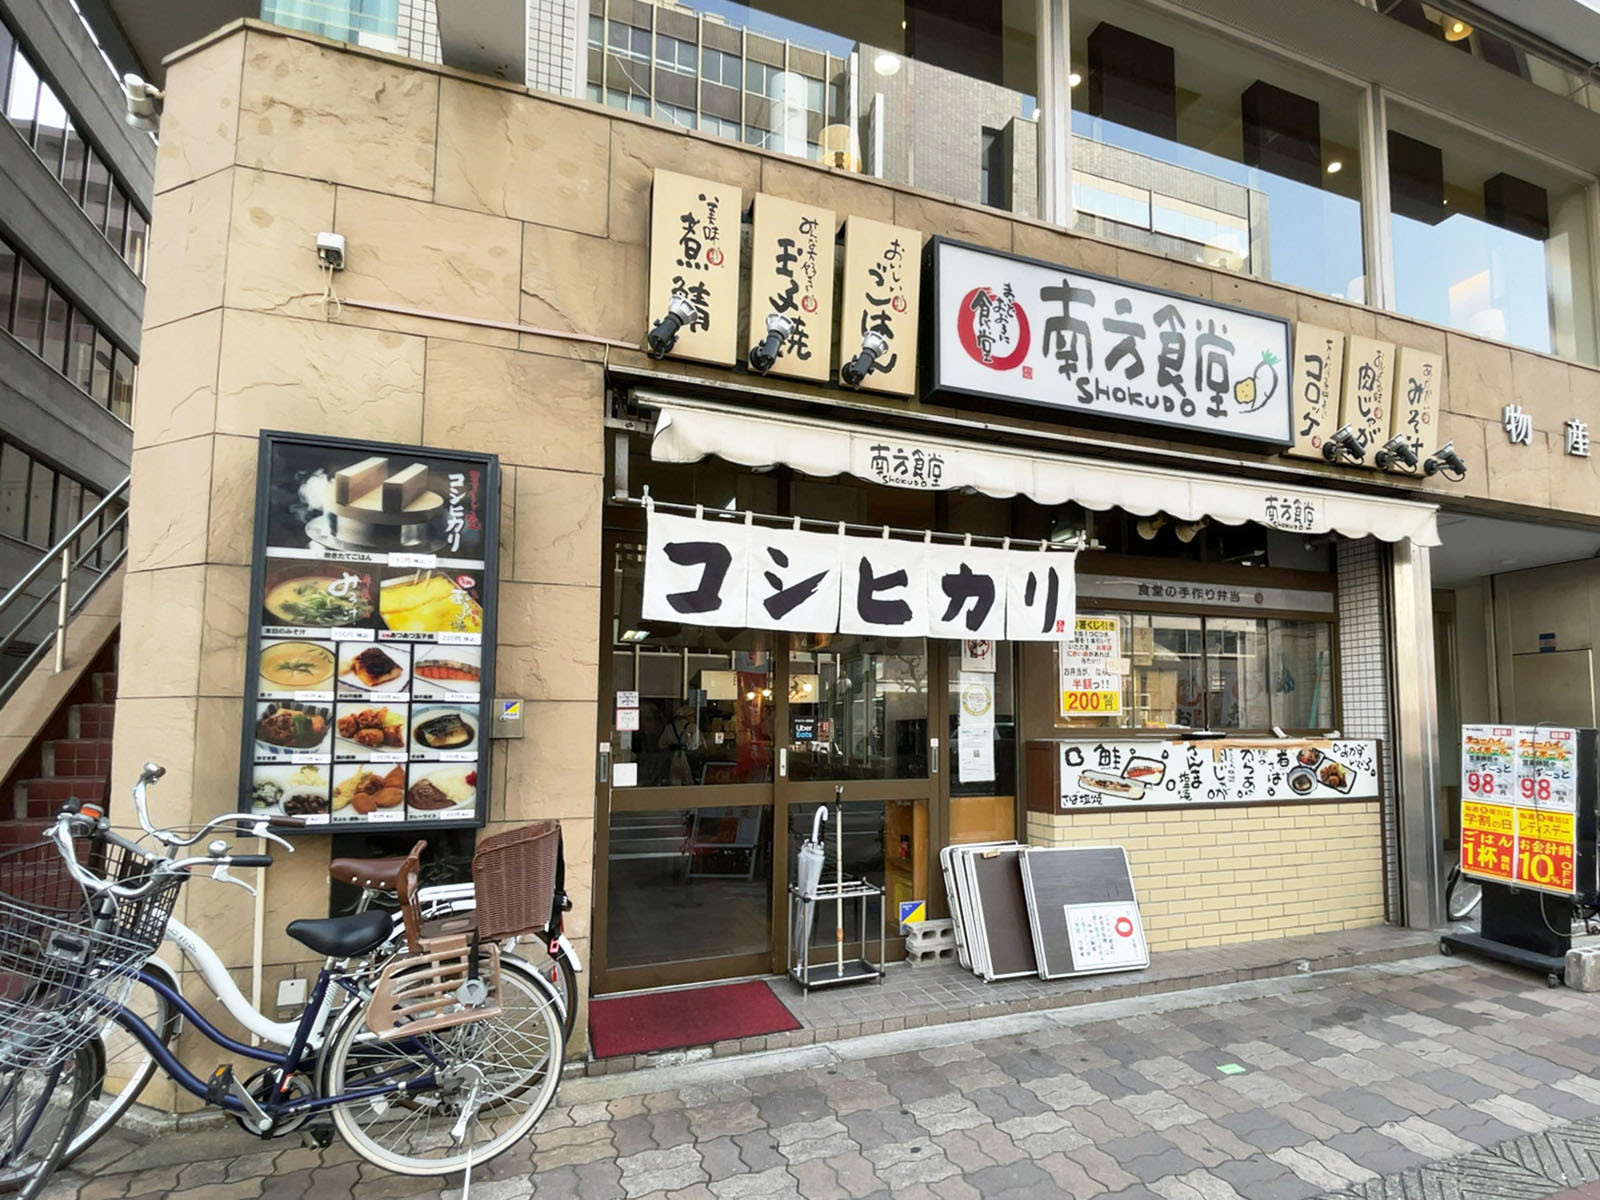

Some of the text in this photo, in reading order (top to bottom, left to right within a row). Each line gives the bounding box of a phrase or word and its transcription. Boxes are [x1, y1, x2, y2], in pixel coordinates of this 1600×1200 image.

[884, 239, 906, 293] おいしい
[769, 238, 812, 360] 玉子焼
[861, 263, 898, 374] ごはん
[971, 290, 996, 363] 食堂
[1040, 279, 1235, 418] 南方食堂
[1076, 377, 1197, 417] SHOKUDO
[1300, 354, 1324, 437] コロッケ
[1407, 377, 1424, 457] みそ汁
[870, 444, 944, 487] 南方食堂
[882, 475, 927, 488] SHOKUDO
[445, 473, 466, 553] コシヒカリ
[1265, 495, 1315, 530] 南方食堂
[663, 542, 1059, 634] コシヒカリ
[1138, 582, 1240, 603] 食堂の手作り弁当
[1068, 692, 1100, 711] 200
[1465, 736, 1504, 746] チューハイ
[1468, 746, 1508, 755] ハイボール
[1519, 739, 1561, 749] チューハイ
[1093, 744, 1121, 770] 鮭
[1521, 751, 1566, 759] ハイボール
[1468, 773, 1494, 794] 98
[1521, 778, 1551, 801] 98
[1464, 831, 1513, 848] ごはん
[1520, 839, 1572, 858] お会計時
[1464, 843, 1498, 868] 1杯
